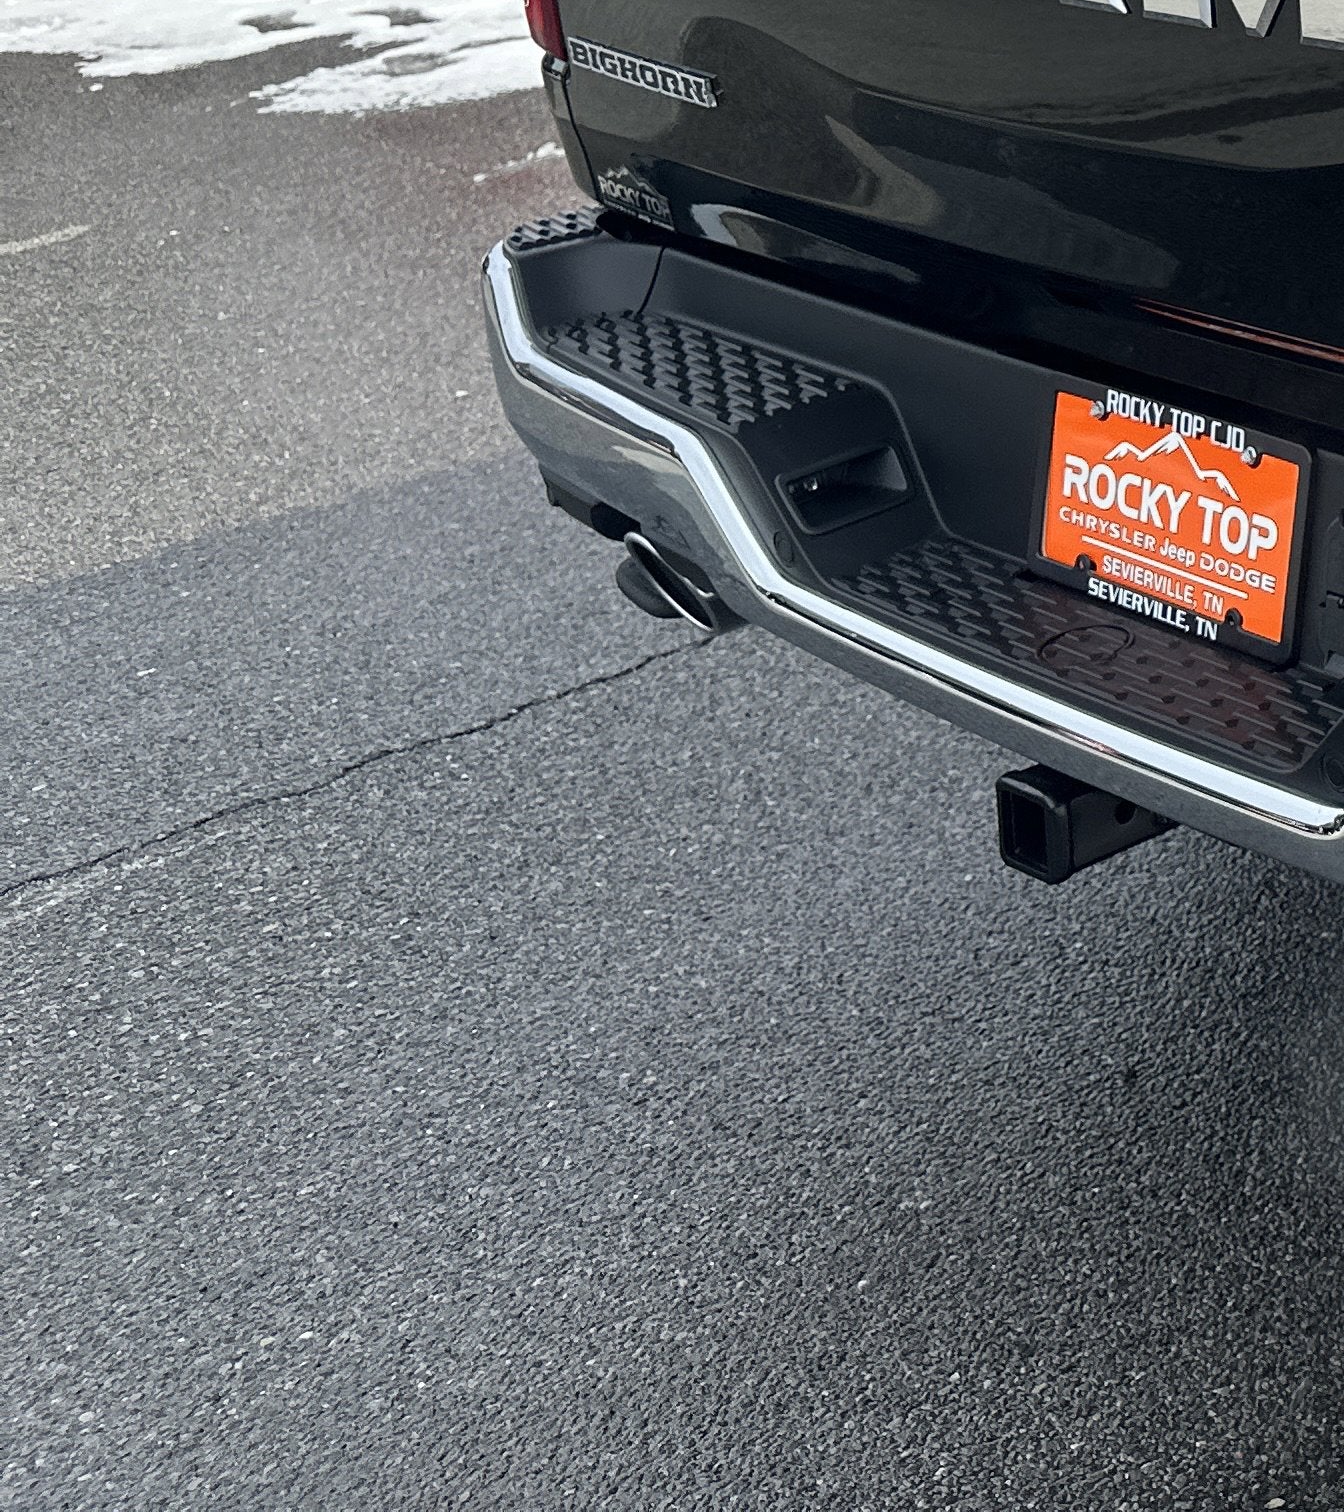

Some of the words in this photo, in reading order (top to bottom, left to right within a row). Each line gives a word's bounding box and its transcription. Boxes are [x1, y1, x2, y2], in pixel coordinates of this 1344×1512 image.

[567, 36, 718, 108] BIGHORN
[1106, 388, 1165, 428] ROCKY
[1169, 407, 1206, 438] TOP
[1209, 420, 1245, 453] CJD
[1062, 453, 1192, 534] ROCKY
[1197, 495, 1278, 561] TOP
[1058, 505, 1157, 552] CHRYSLER
[1158, 538, 1196, 568] Jeep
[1199, 552, 1277, 594] DODGE
[1087, 577, 1190, 632] SEVIERVILLE,
[1195, 615, 1219, 641] TN
[1102, 555, 1199, 610] SEVIERVILLE,
[1202, 590, 1224, 615] TN
